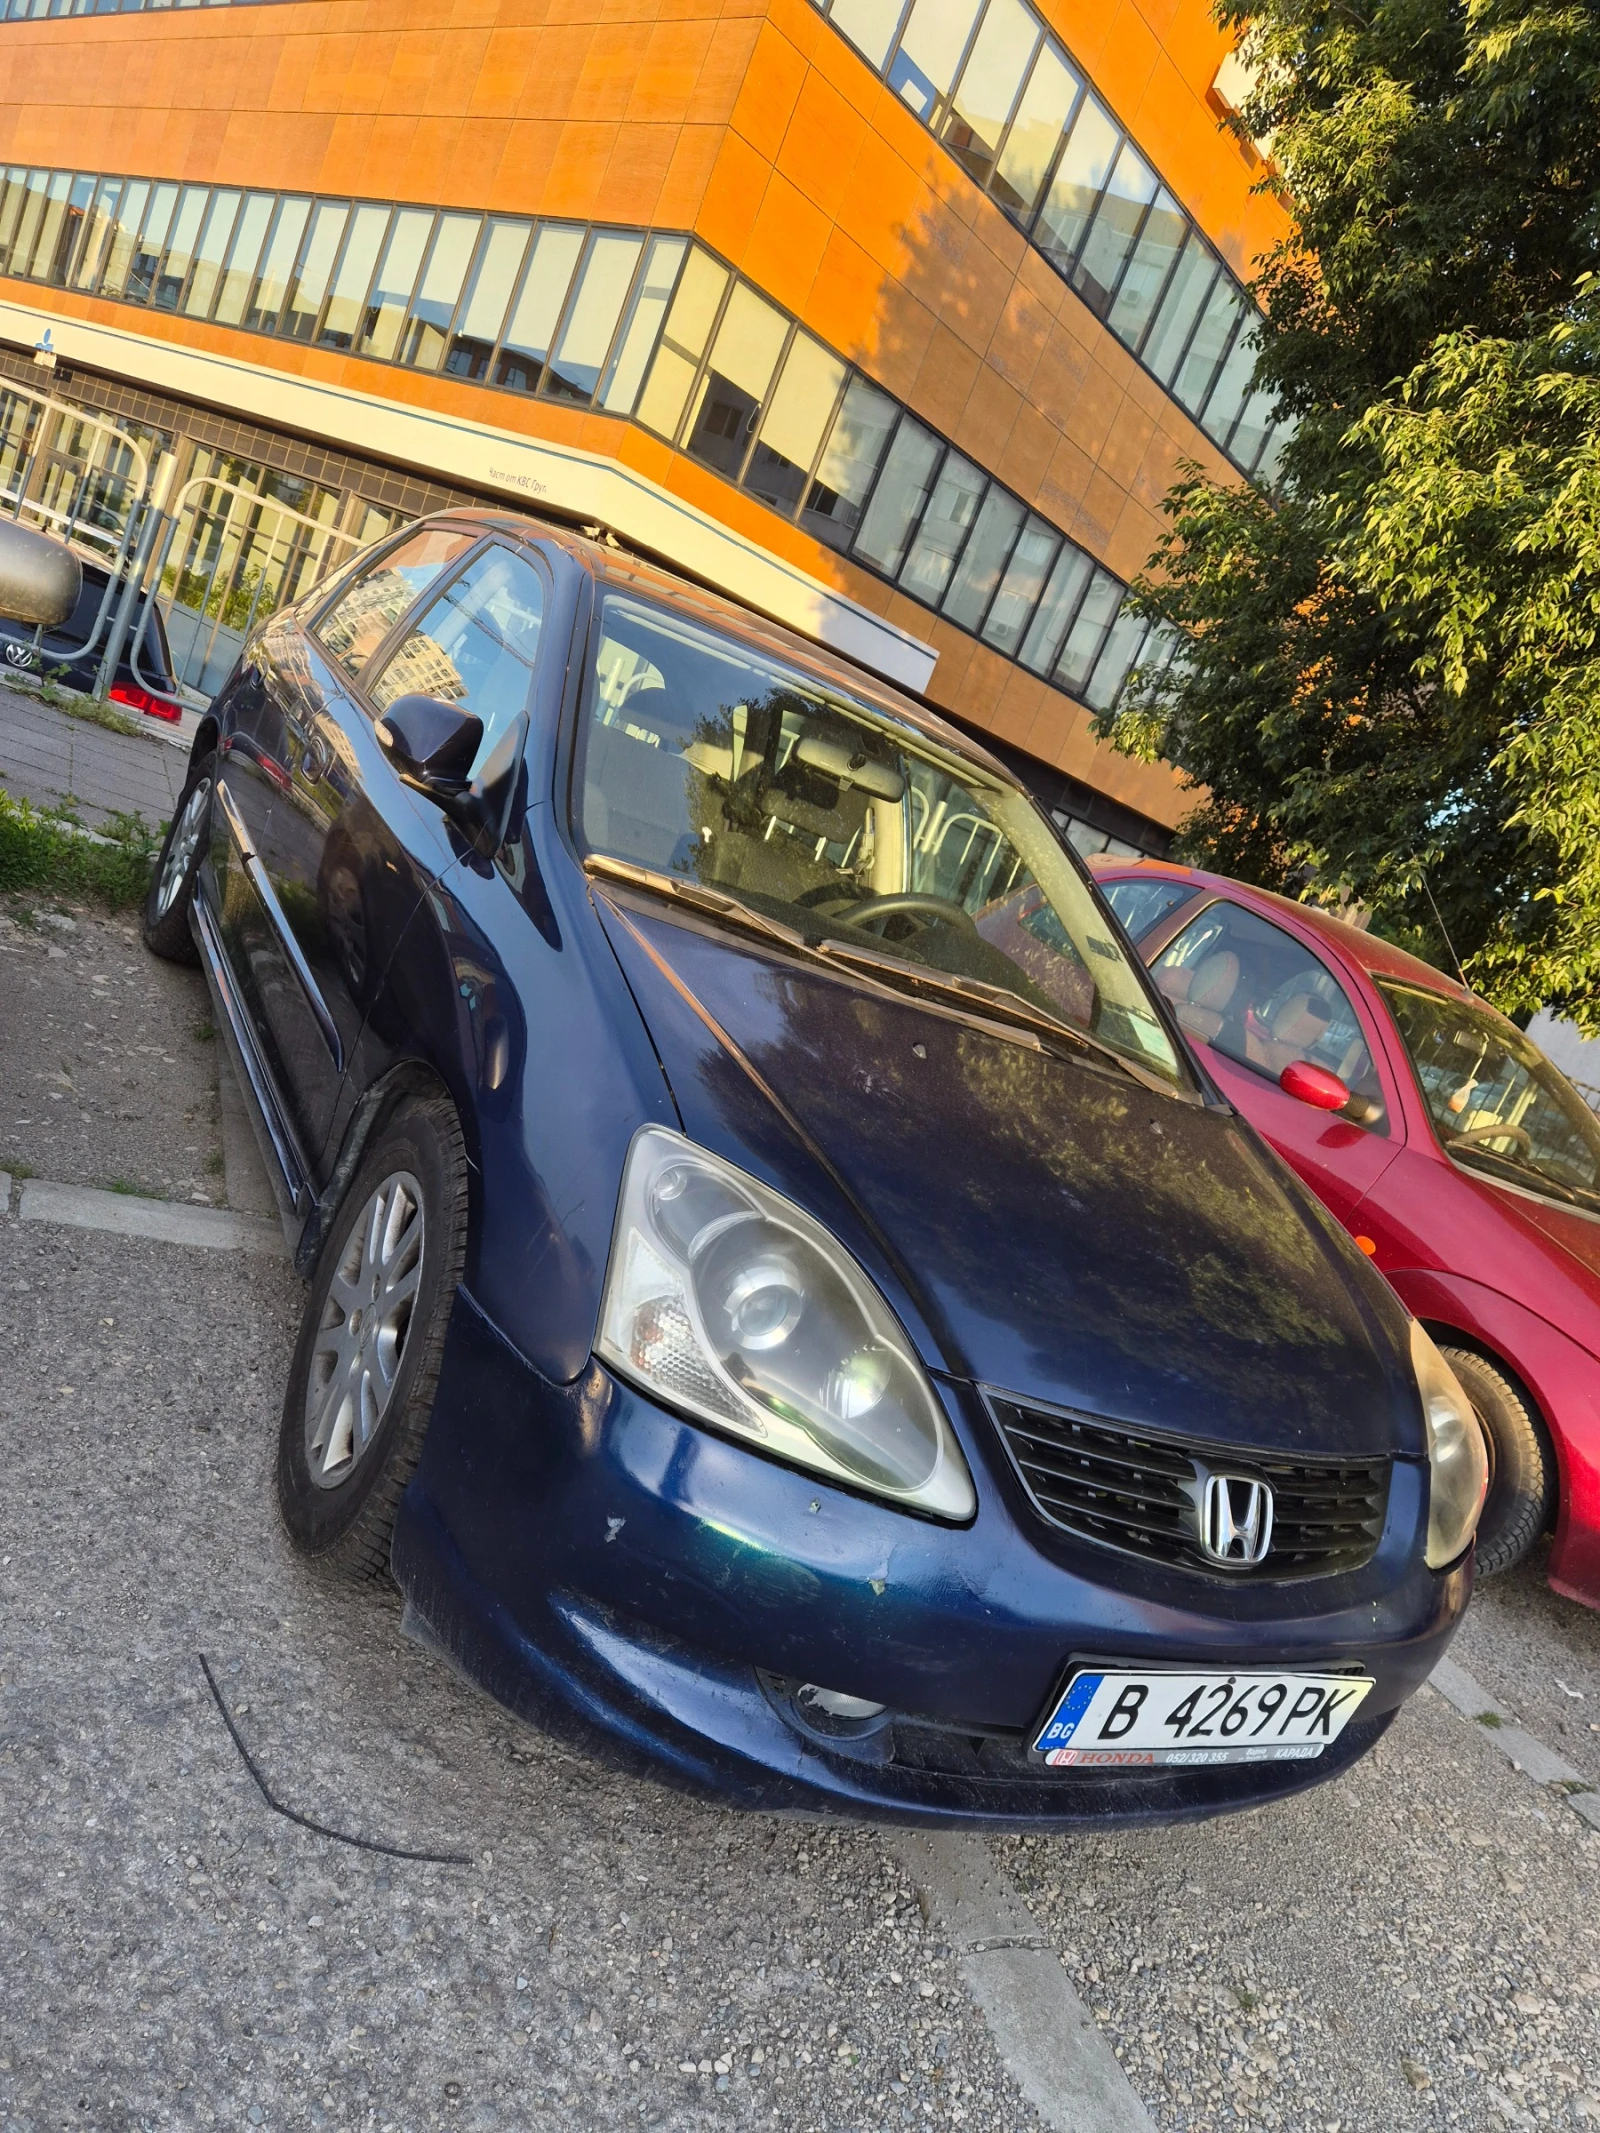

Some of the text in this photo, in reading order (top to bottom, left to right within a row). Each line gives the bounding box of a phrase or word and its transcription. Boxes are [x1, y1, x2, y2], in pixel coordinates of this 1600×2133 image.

[505, 474, 517, 484] от
[1097, 1683, 1358, 1740] B 4269 PK
[1046, 1722, 1074, 1740] BG
[1079, 1753, 1155, 1764] HONDA
[1166, 1752, 1208, 1764] 052/320
